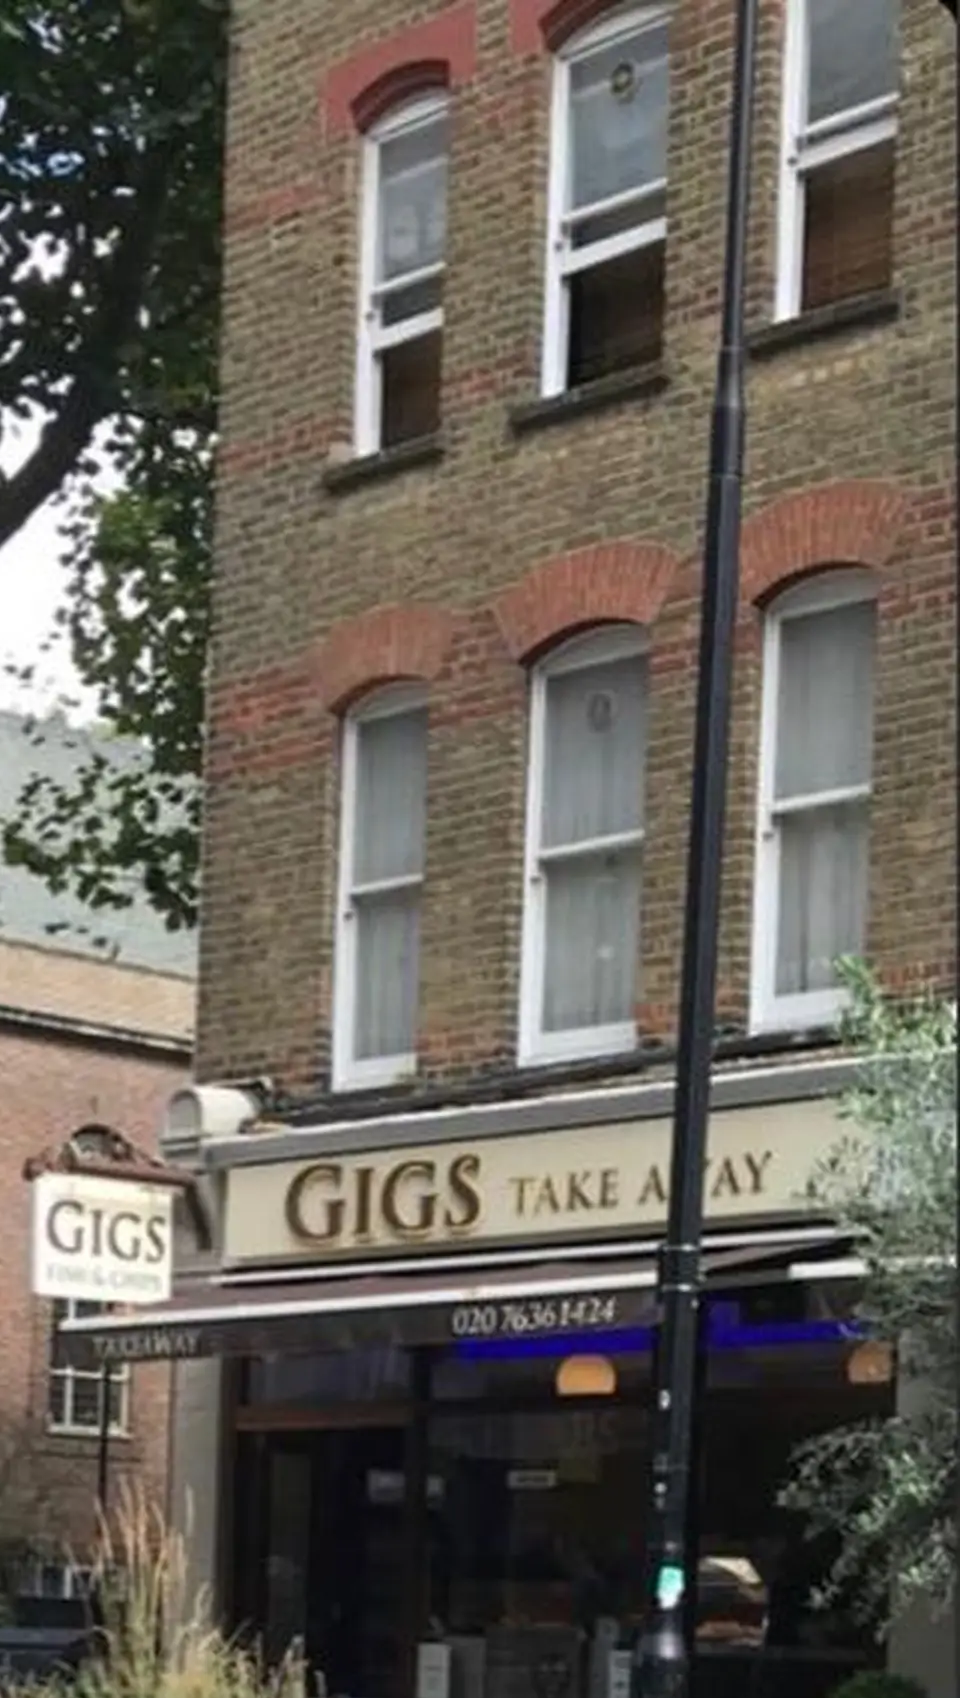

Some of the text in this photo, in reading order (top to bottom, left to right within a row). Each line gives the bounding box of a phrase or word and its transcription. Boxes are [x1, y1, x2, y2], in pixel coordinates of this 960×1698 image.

[284, 1150, 773, 1240] GIGS TAKE AAY
[46, 1199, 166, 1263] GIGS
[452, 1305, 498, 1335] 020
